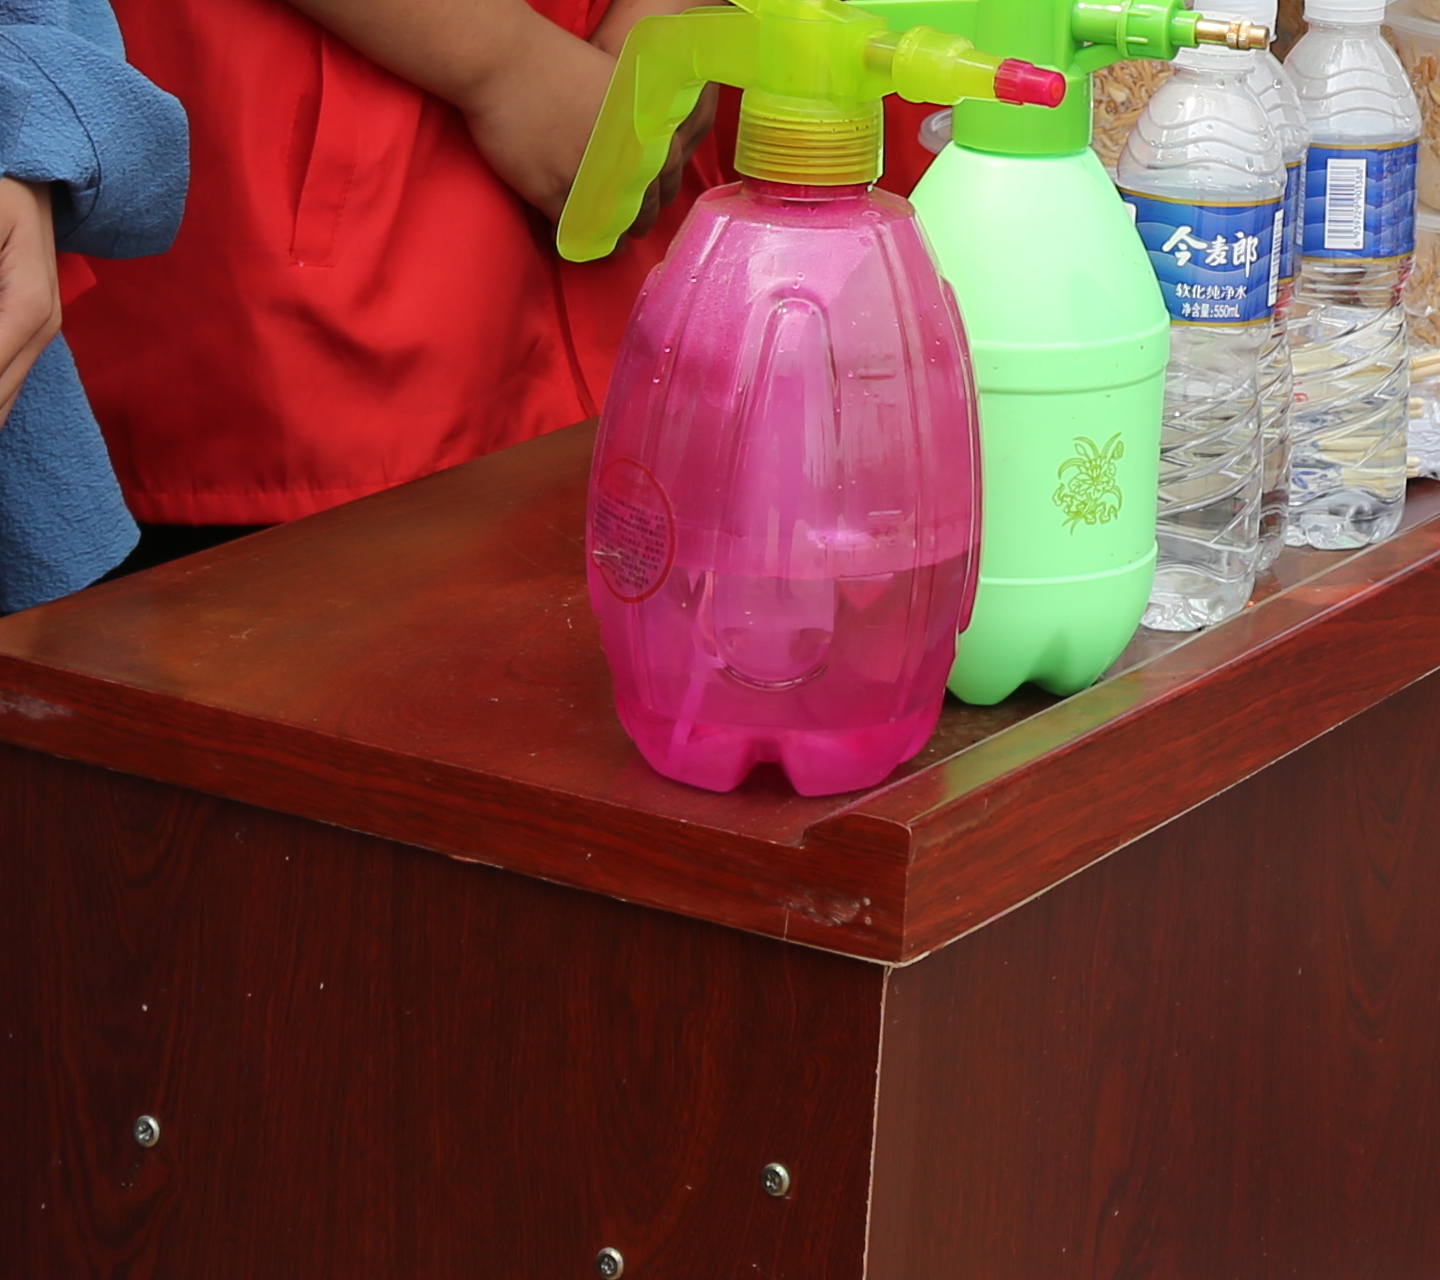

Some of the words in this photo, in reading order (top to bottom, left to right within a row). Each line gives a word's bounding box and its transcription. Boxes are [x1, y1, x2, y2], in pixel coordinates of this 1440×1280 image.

[1162, 225, 1259, 278] 今麦郎
[1175, 283, 1247, 300] 软化纯净水
